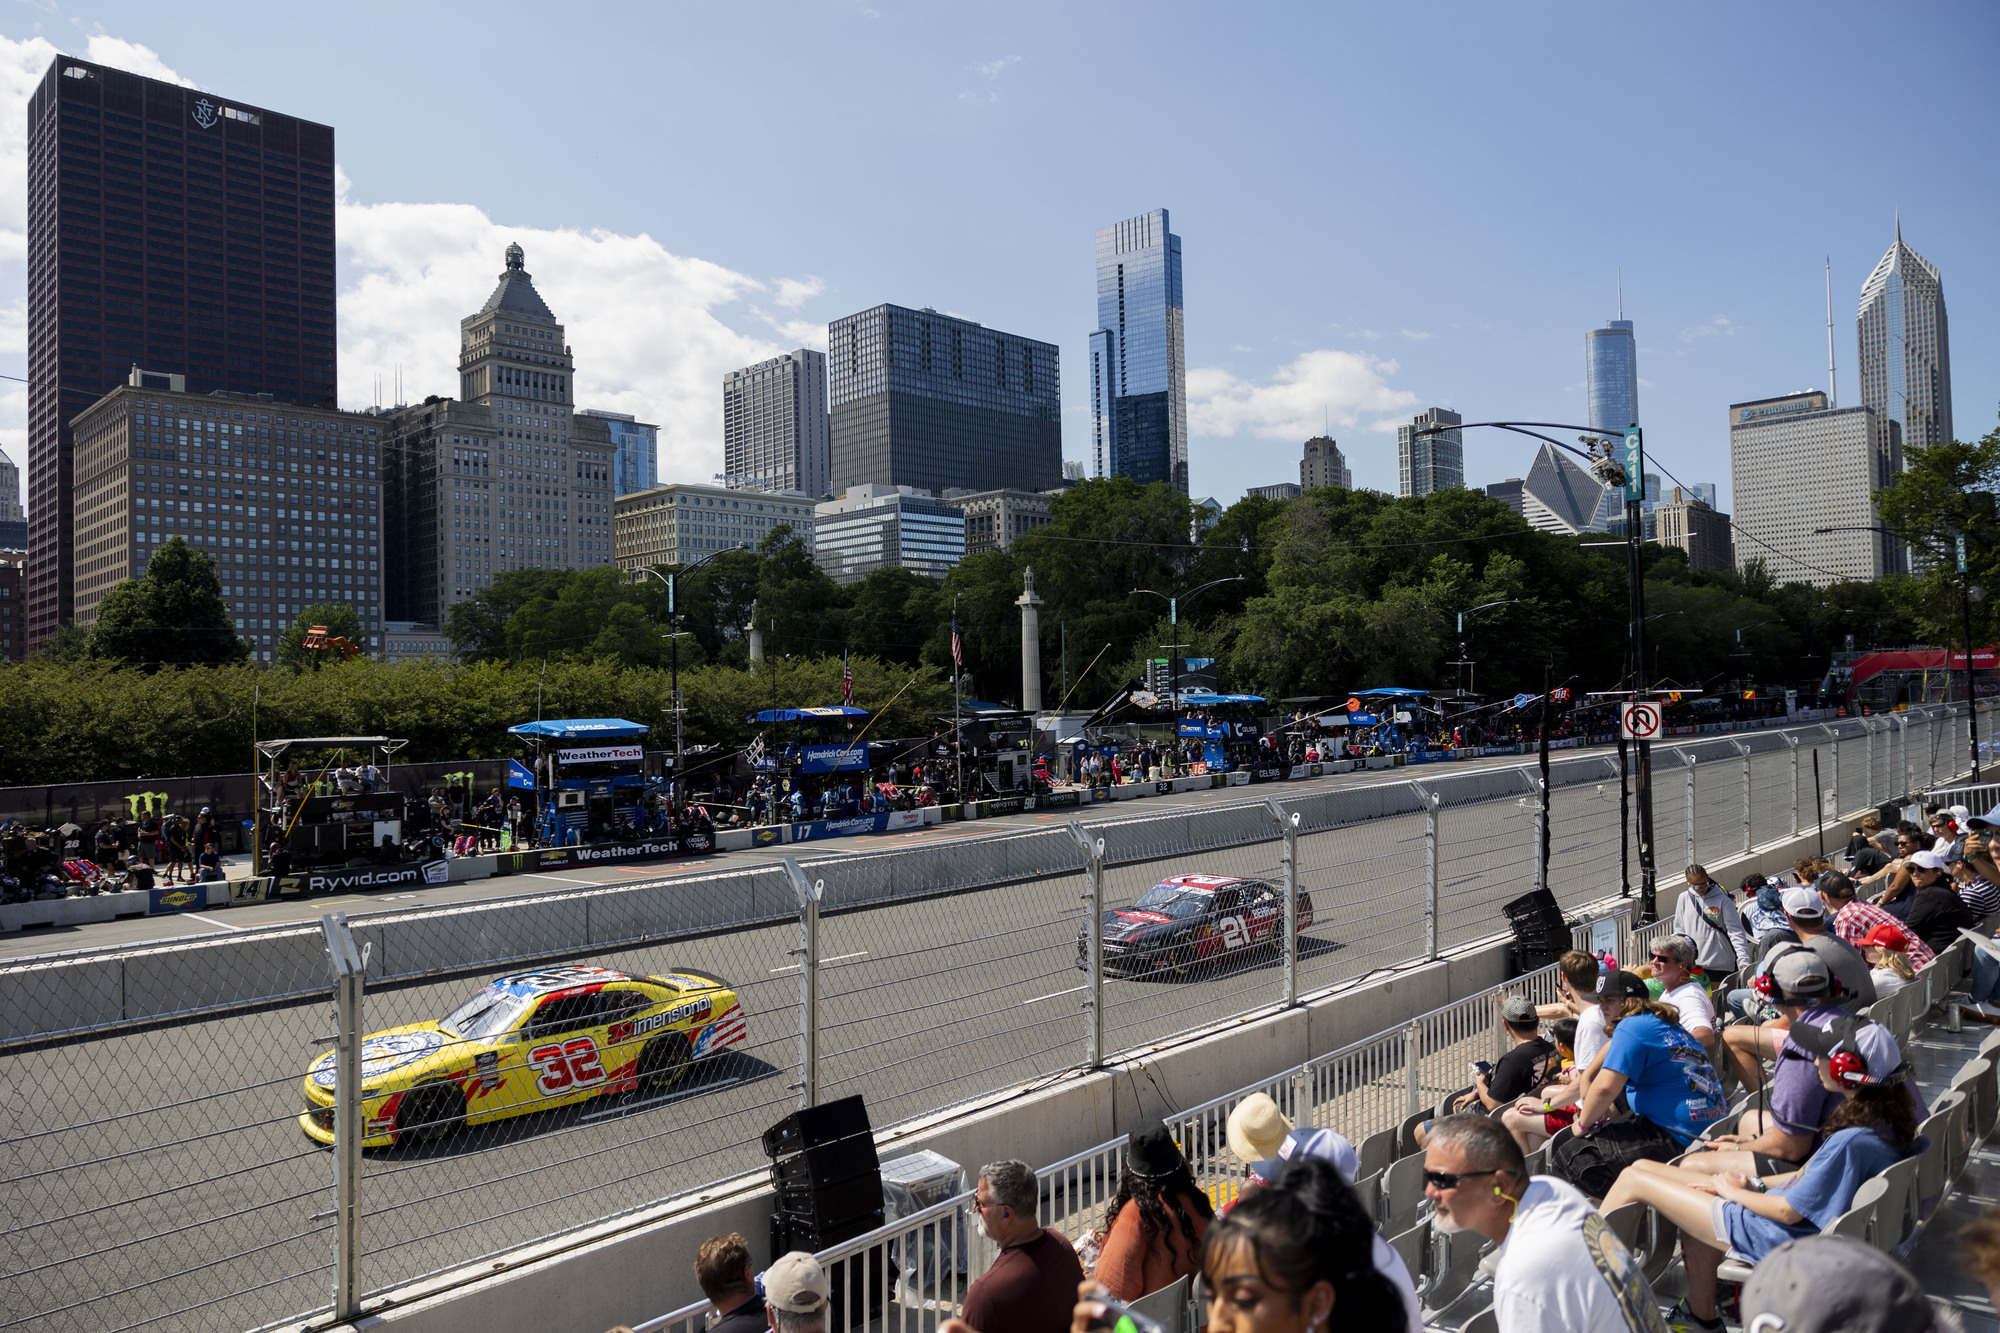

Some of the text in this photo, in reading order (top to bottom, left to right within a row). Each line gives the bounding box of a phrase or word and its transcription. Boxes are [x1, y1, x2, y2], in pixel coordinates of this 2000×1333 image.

[1756, 400, 1810, 417] Prudential
[1625, 434, 1639, 493] C411
[1956, 537, 1966, 569] C401
[1745, 691, 1753, 699] 7
[560, 749, 641, 760] WeatherTech
[1193, 763, 1205, 775] 16
[1258, 768, 1280, 777] CELSIUS
[1158, 782, 1168, 791] 32
[990, 800, 1019, 809] MONSTER
[797, 825, 812, 840] 17
[64, 839, 80, 849] 28
[576, 841, 678, 861] WeatherTech
[309, 870, 417, 891] Ryvid.com
[235, 879, 262, 900] 14
[160, 894, 197, 905] SUNOCO
[1219, 914, 1251, 949] 21
[528, 1036, 608, 1096] 32
